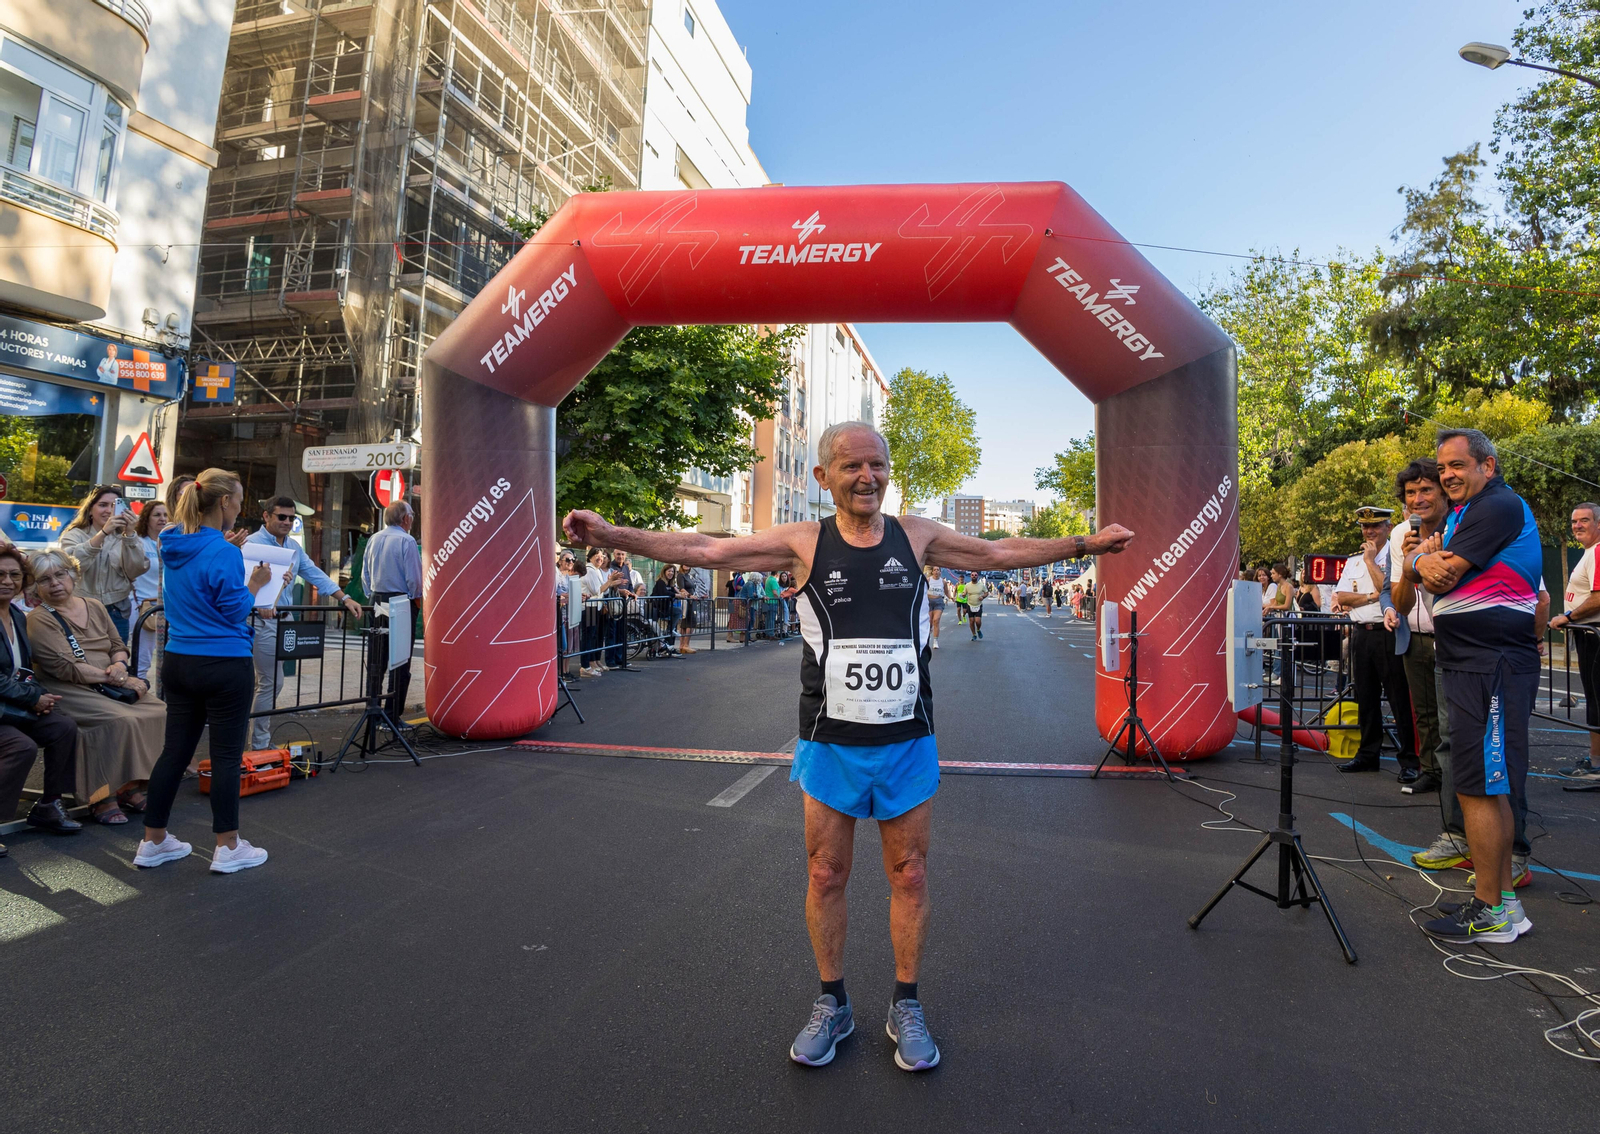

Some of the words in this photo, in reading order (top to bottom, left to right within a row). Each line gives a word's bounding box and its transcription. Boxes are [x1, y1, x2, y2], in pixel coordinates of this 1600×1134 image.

[738, 242, 882, 266] TEAMERGY
[479, 263, 578, 373] TEAMERGY
[1045, 256, 1165, 361] TEAMERGY
[10, 330, 49, 347] HORAS
[46, 352, 53, 360] Y
[54, 354, 86, 368] ARMAS
[19, 522, 50, 530] SALUD
[32, 514, 52, 522] ISLA
[293, 518, 300, 532] P
[1120, 474, 1232, 612] www.teamergy.es
[845, 663, 903, 691] 590
[1490, 695, 1499, 713] Páez
[1490, 714, 1500, 748] Carmona
